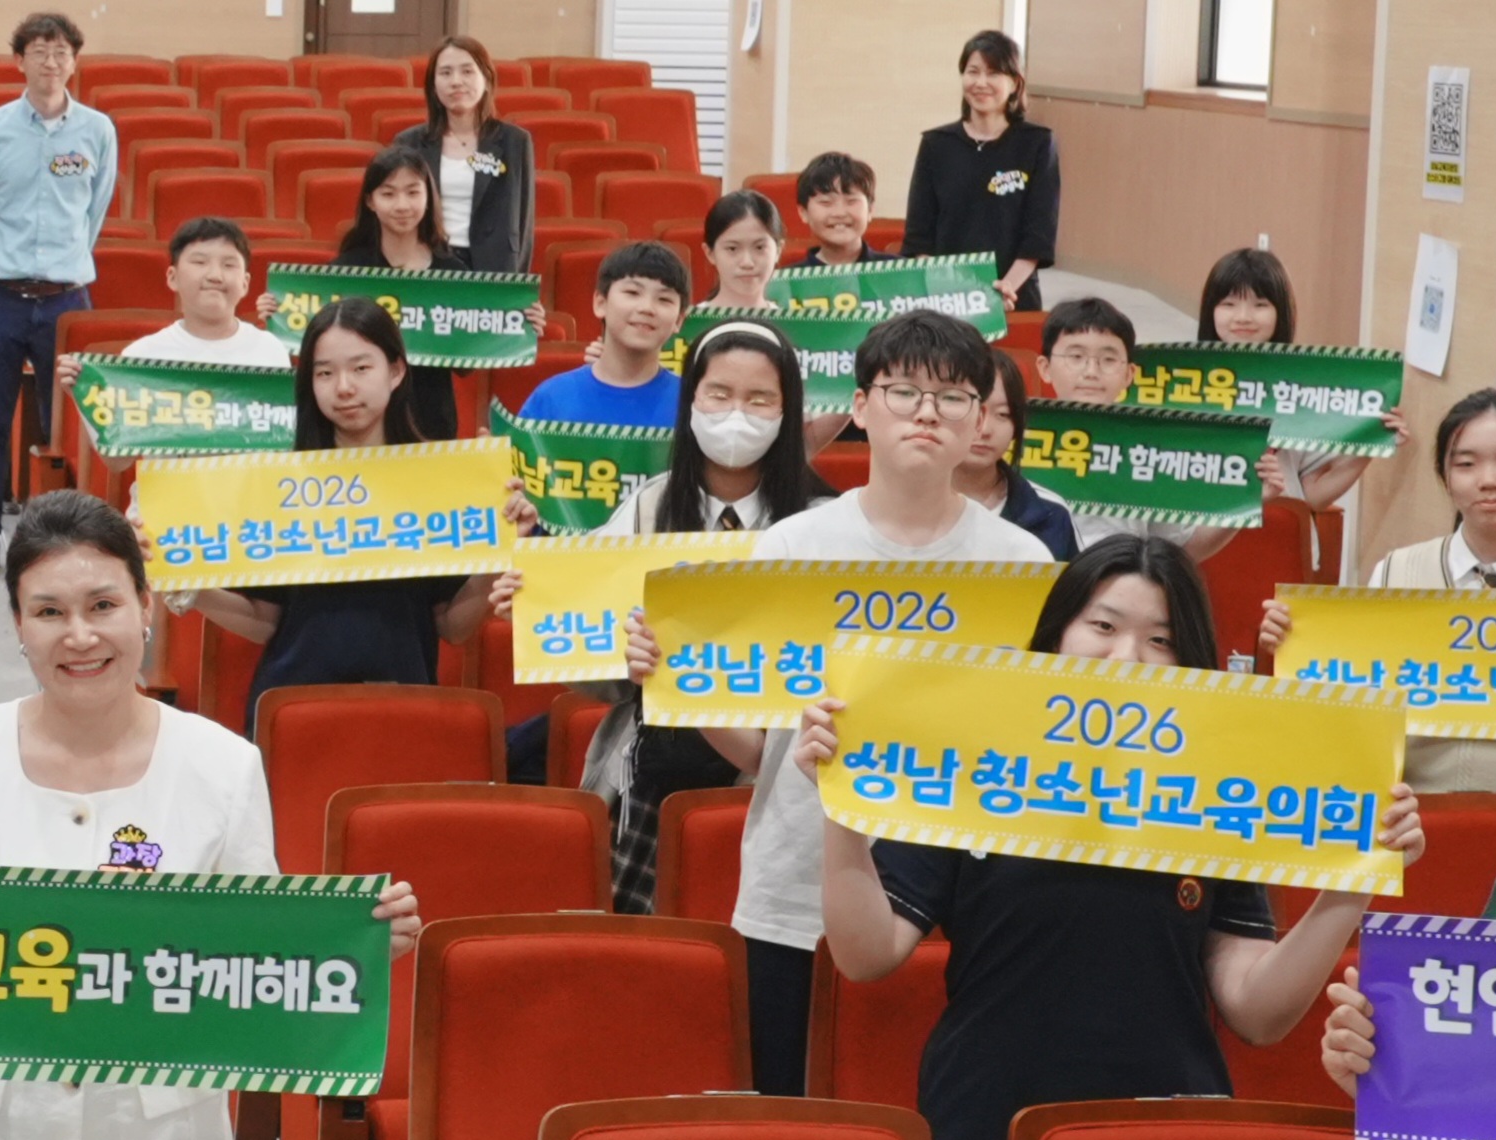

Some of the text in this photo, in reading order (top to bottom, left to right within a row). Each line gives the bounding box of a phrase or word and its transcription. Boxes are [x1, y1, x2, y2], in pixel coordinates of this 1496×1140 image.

[430, 304, 526, 335] 함께해요
[82, 385, 298, 432] 성남교육과 함께
[1116, 365, 1385, 418] 남교육과 함께해요
[511, 445, 648, 508] 남교육과
[1010, 429, 1248, 487] 교육과 함께해요
[277, 474, 369, 509] 2026
[156, 505, 498, 565] 성남 청소년교육의회
[532, 609, 616, 655] 성남
[833, 589, 957, 632] 2026
[666, 641, 766, 695] 성남
[1042, 694, 1184, 754] 2026
[842, 741, 1377, 853] 성남 청소년교육의회
[143, 946, 362, 1015] 함께해요
